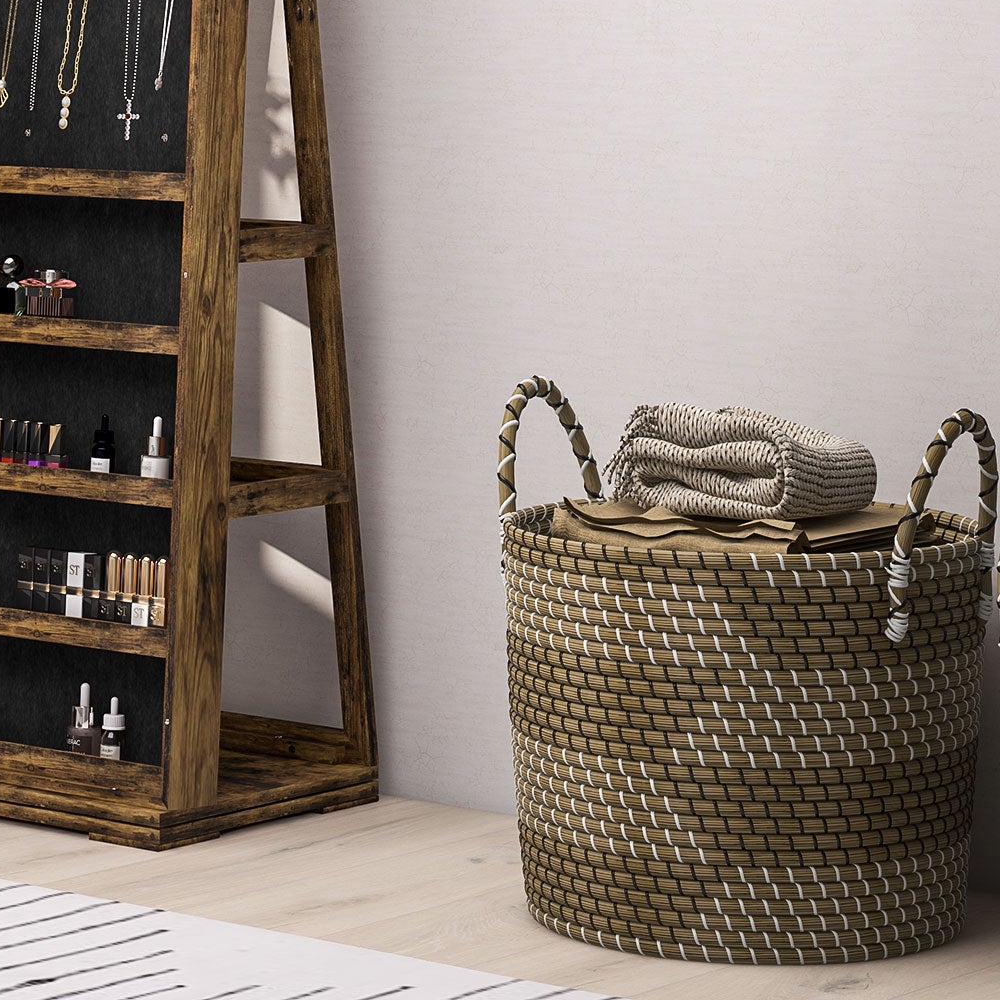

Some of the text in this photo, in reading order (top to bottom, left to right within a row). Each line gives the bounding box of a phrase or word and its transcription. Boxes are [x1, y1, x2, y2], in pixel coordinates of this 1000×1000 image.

[69, 564, 80, 576] ST
[117, 605, 127, 617] ST
[133, 607, 144, 619] ST
